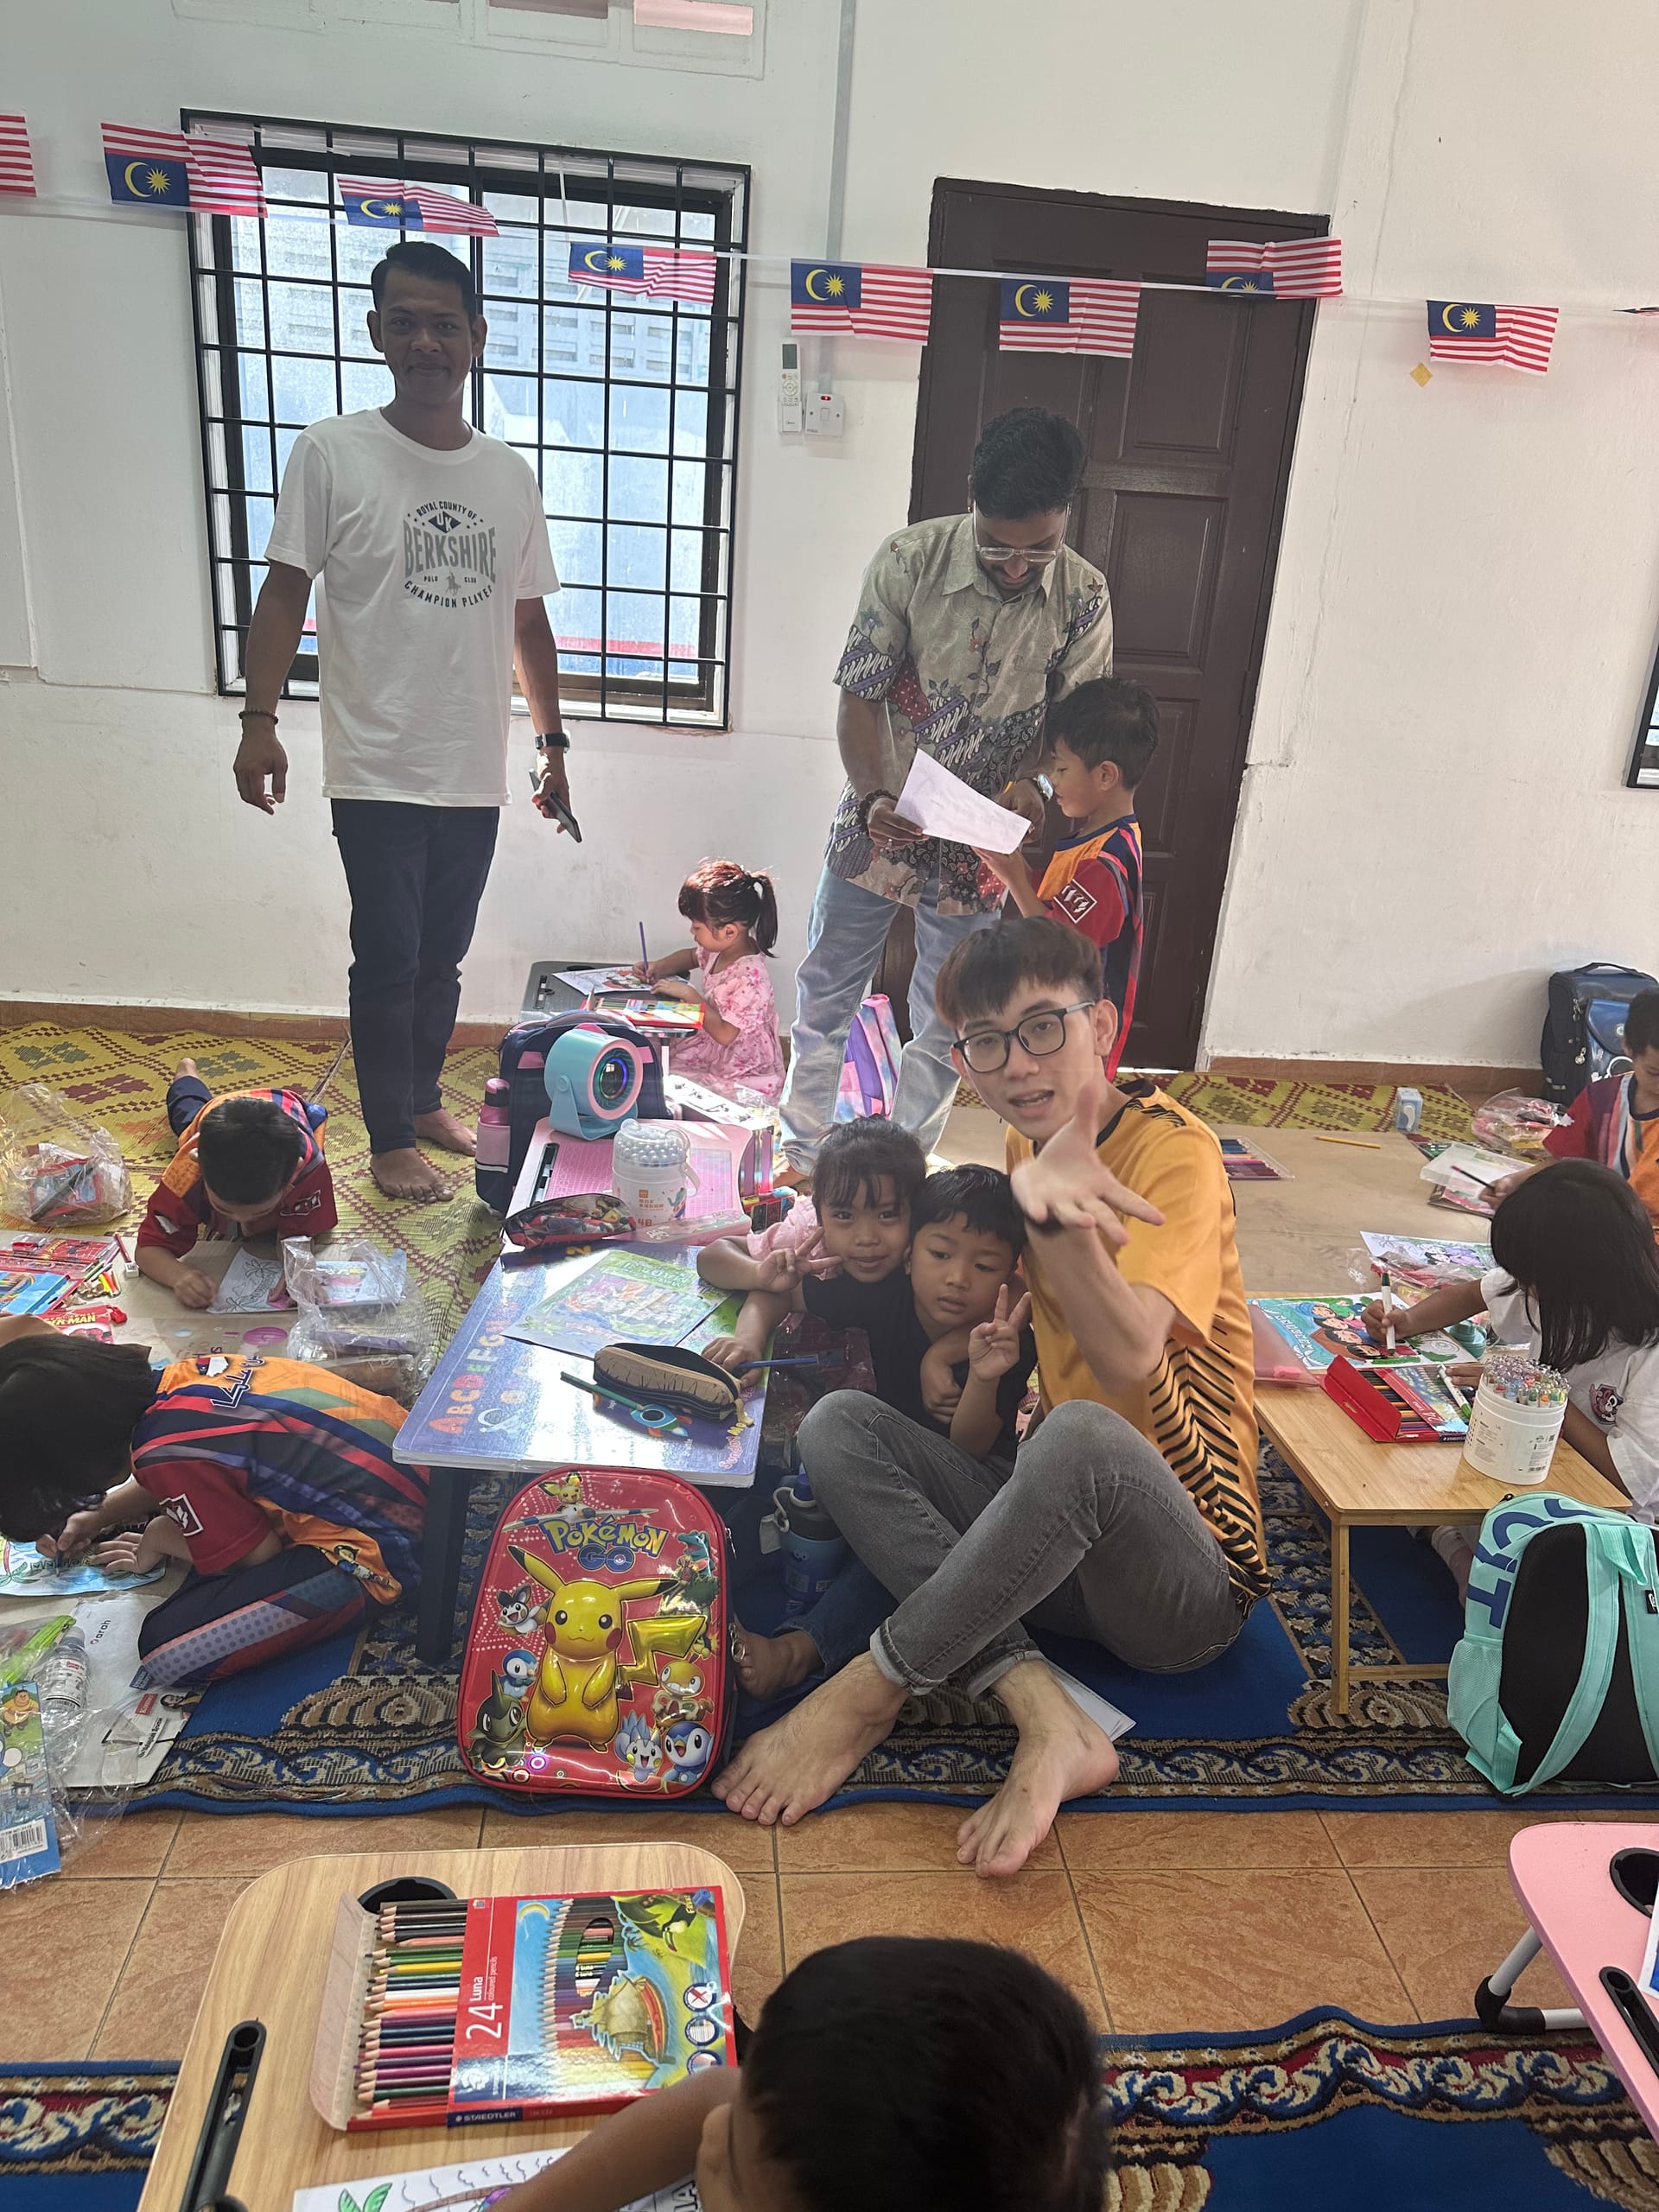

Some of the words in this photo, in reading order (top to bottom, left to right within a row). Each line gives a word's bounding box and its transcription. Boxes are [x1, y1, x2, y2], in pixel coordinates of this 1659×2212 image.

[416, 501, 437, 517] ROYAL
[439, 500, 467, 515] COUNTY
[467, 510, 477, 519] OF
[403, 519, 496, 583] BERKSHIRE
[404, 580, 457, 608] CHAMPION
[576, 1544, 636, 1573] GO
[488, 1956, 499, 1975] pencils
[469, 1976, 484, 2002] Luna
[487, 1976, 497, 1999] coloured
[466, 2002, 504, 2040] 24
[463, 2111, 516, 2123] STAEDTLER
